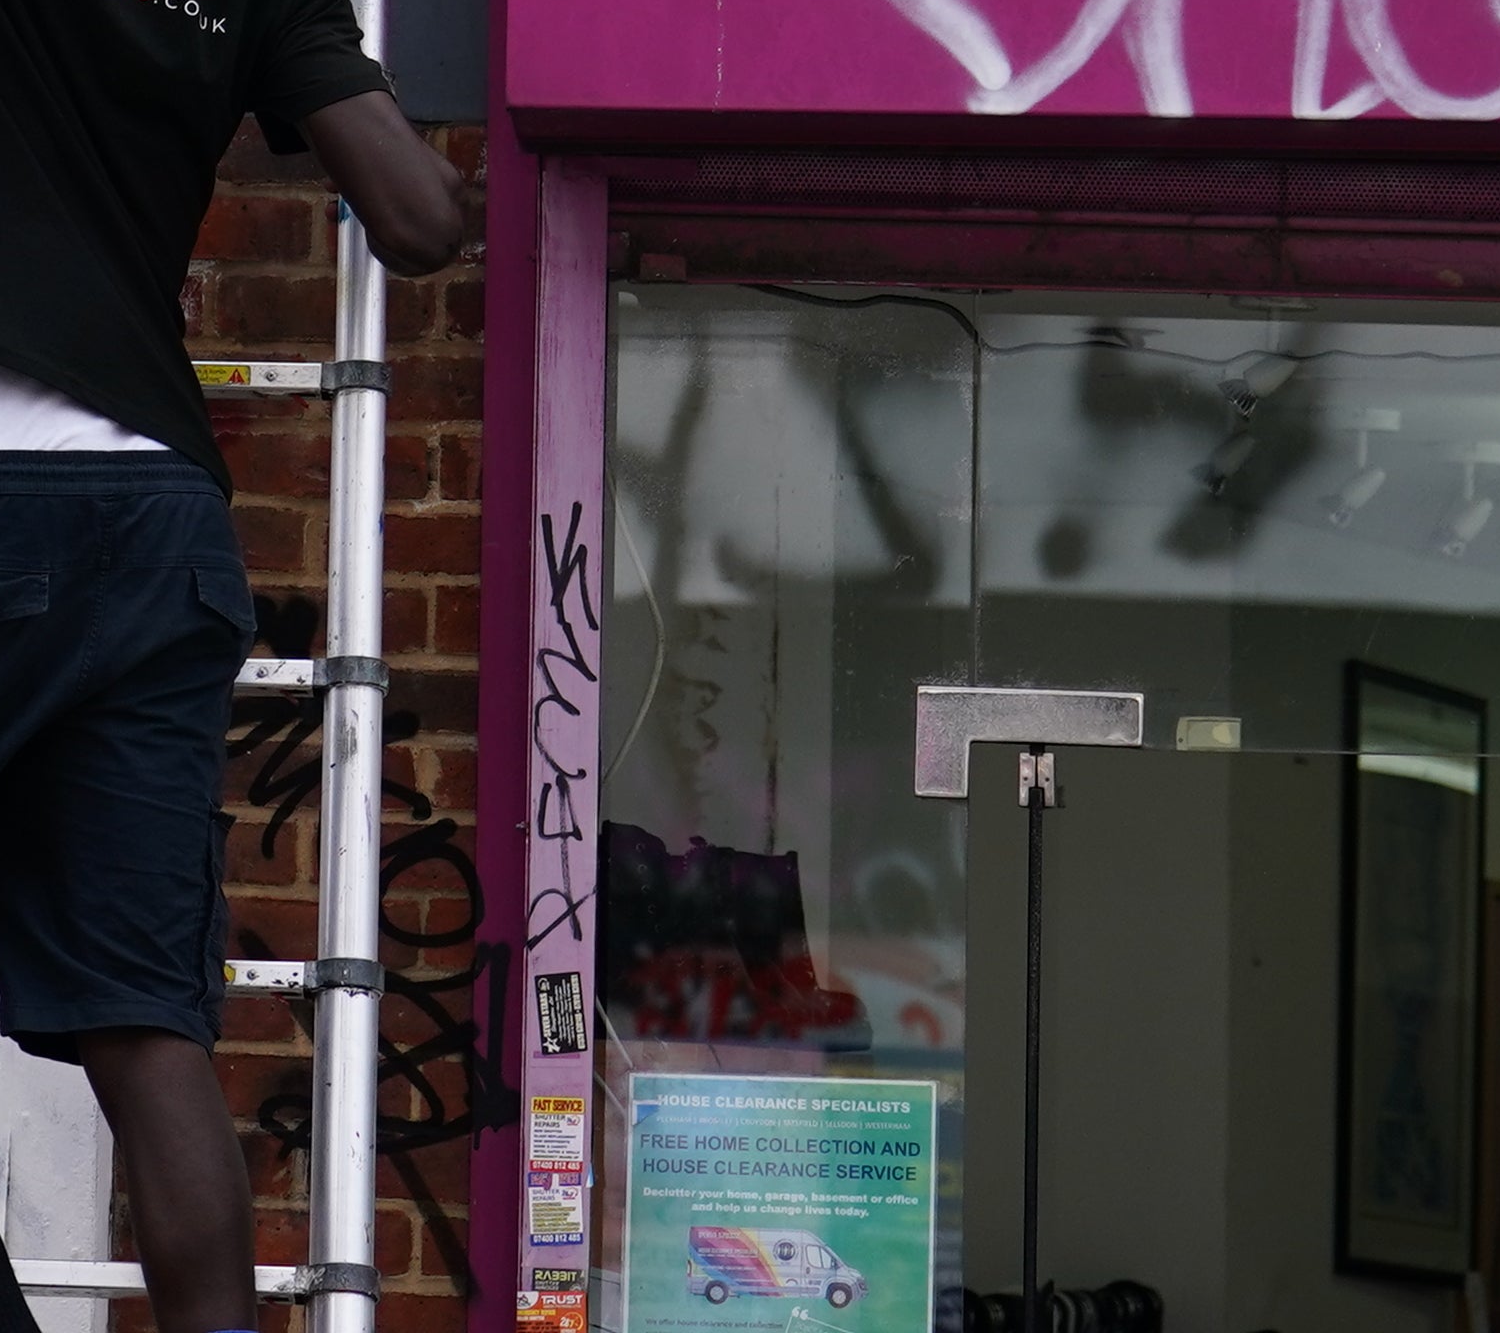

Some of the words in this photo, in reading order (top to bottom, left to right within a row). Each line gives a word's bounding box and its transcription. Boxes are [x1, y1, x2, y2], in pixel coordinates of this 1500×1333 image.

[533, 1099, 552, 1111] FAST
[552, 1100, 583, 1112] SERVICE
[658, 1095, 711, 1108] HOUSE
[715, 1096, 807, 1110] CLEARANCE
[811, 1099, 911, 1114] SPECIALISTS
[640, 1134, 689, 1150] FREE
[695, 1136, 749, 1151] HOME
[756, 1137, 876, 1155] COLLECTION
[880, 1141, 921, 1157] AND
[643, 1158, 708, 1175] HOUSE
[714, 1161, 830, 1179] CLEARANCE
[836, 1164, 917, 1181] SERVICE
[643, 1187, 697, 1198] Declutter
[699, 1189, 724, 1200] your
[727, 1189, 762, 1201] home,
[765, 1192, 807, 1204] garage,
[811, 1192, 867, 1204] basement
[871, 1195, 883, 1204] or
[885, 1194, 919, 1205] office
[692, 1202, 713, 1212] and
[716, 1202, 741, 1214] help
[744, 1205, 757, 1213] us
[760, 1204, 801, 1216] change
[805, 1204, 832, 1215] lives
[835, 1205, 869, 1218] today.
[534, 1270, 577, 1282] RABBIT
[541, 1294, 584, 1305] TRUST
